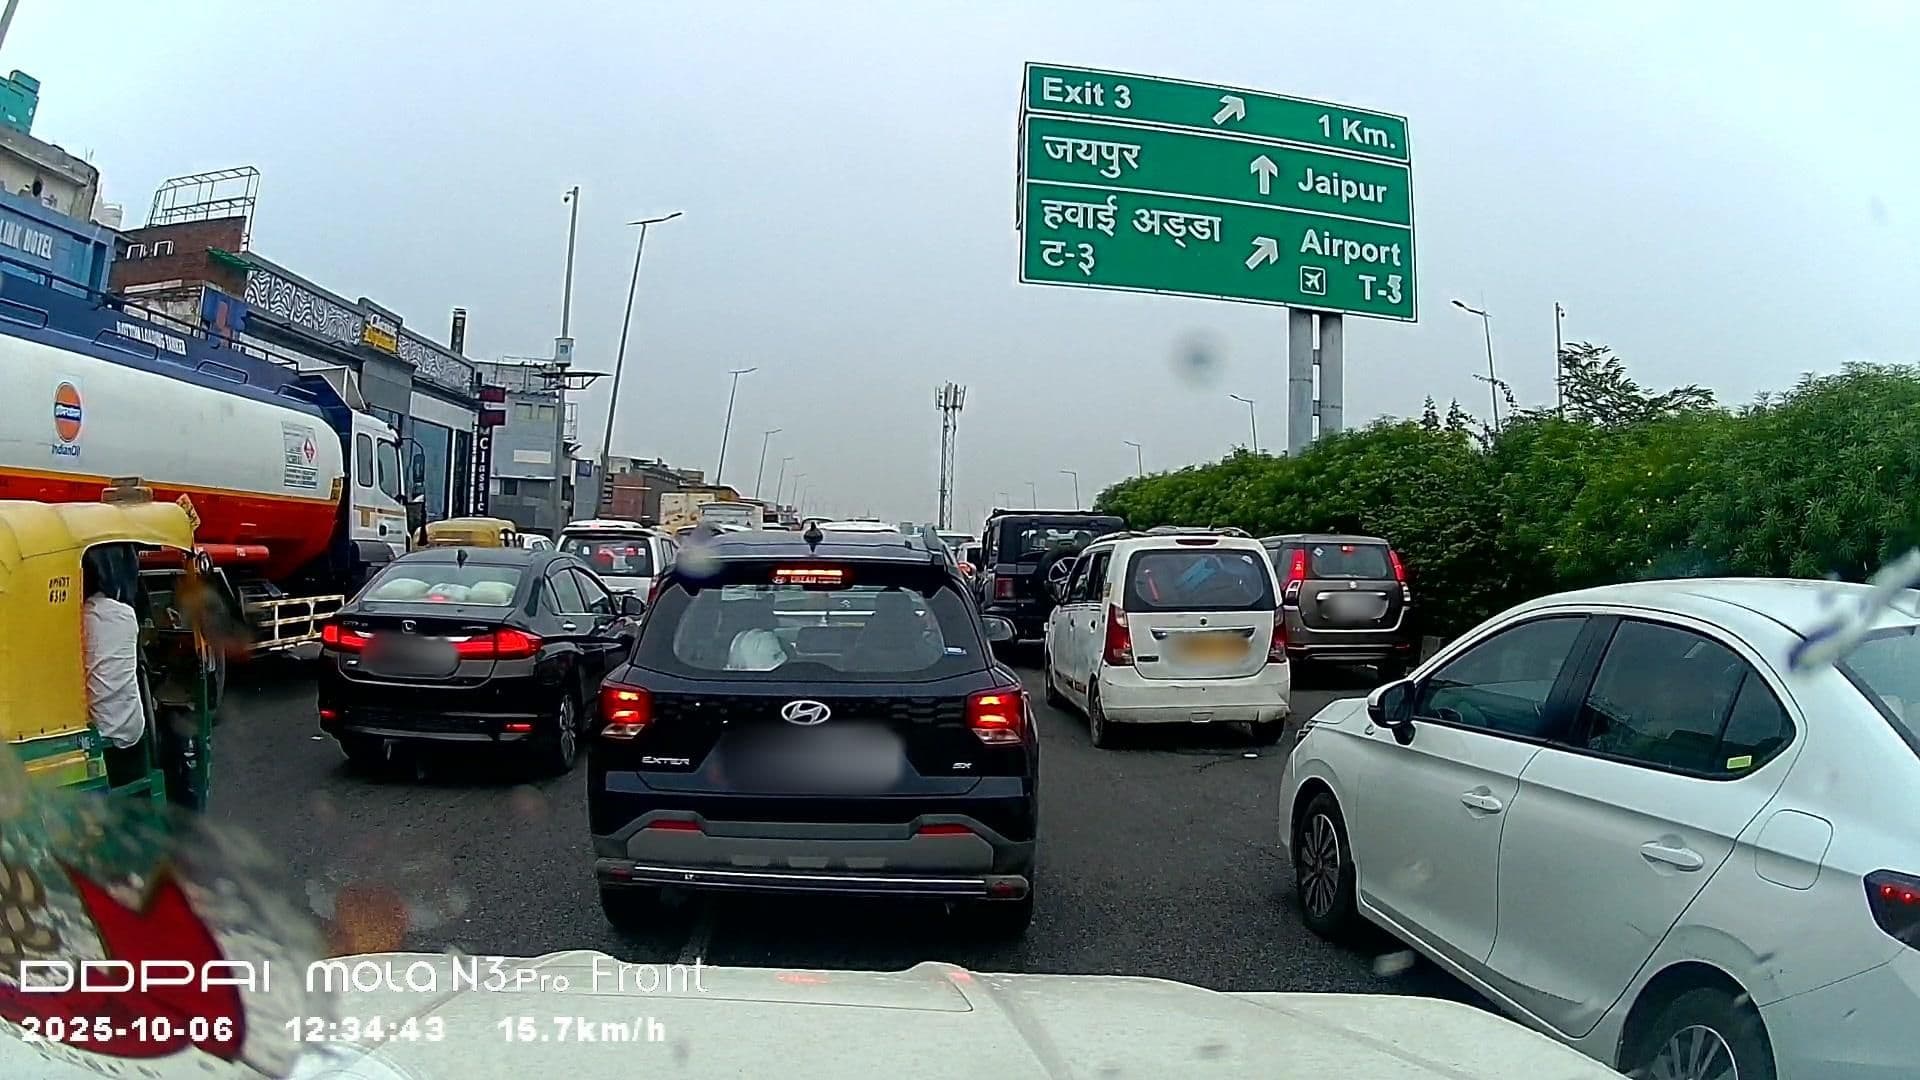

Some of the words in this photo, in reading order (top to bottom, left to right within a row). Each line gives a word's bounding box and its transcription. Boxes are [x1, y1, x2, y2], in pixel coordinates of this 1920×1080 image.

[1042, 76, 1104, 106] Exit
[1114, 85, 1132, 108] 3
[1318, 114, 1330, 138] 1
[1342, 118, 1397, 149] Km.
[1041, 136, 1141, 178] जयपुर
[1298, 168, 1388, 204] Jaipur
[1041, 195, 1118, 237] हवाई
[1040, 240, 1096, 276] ट-३
[1300, 229, 1402, 267] Airport
[641, 756, 690, 766] EXTER
